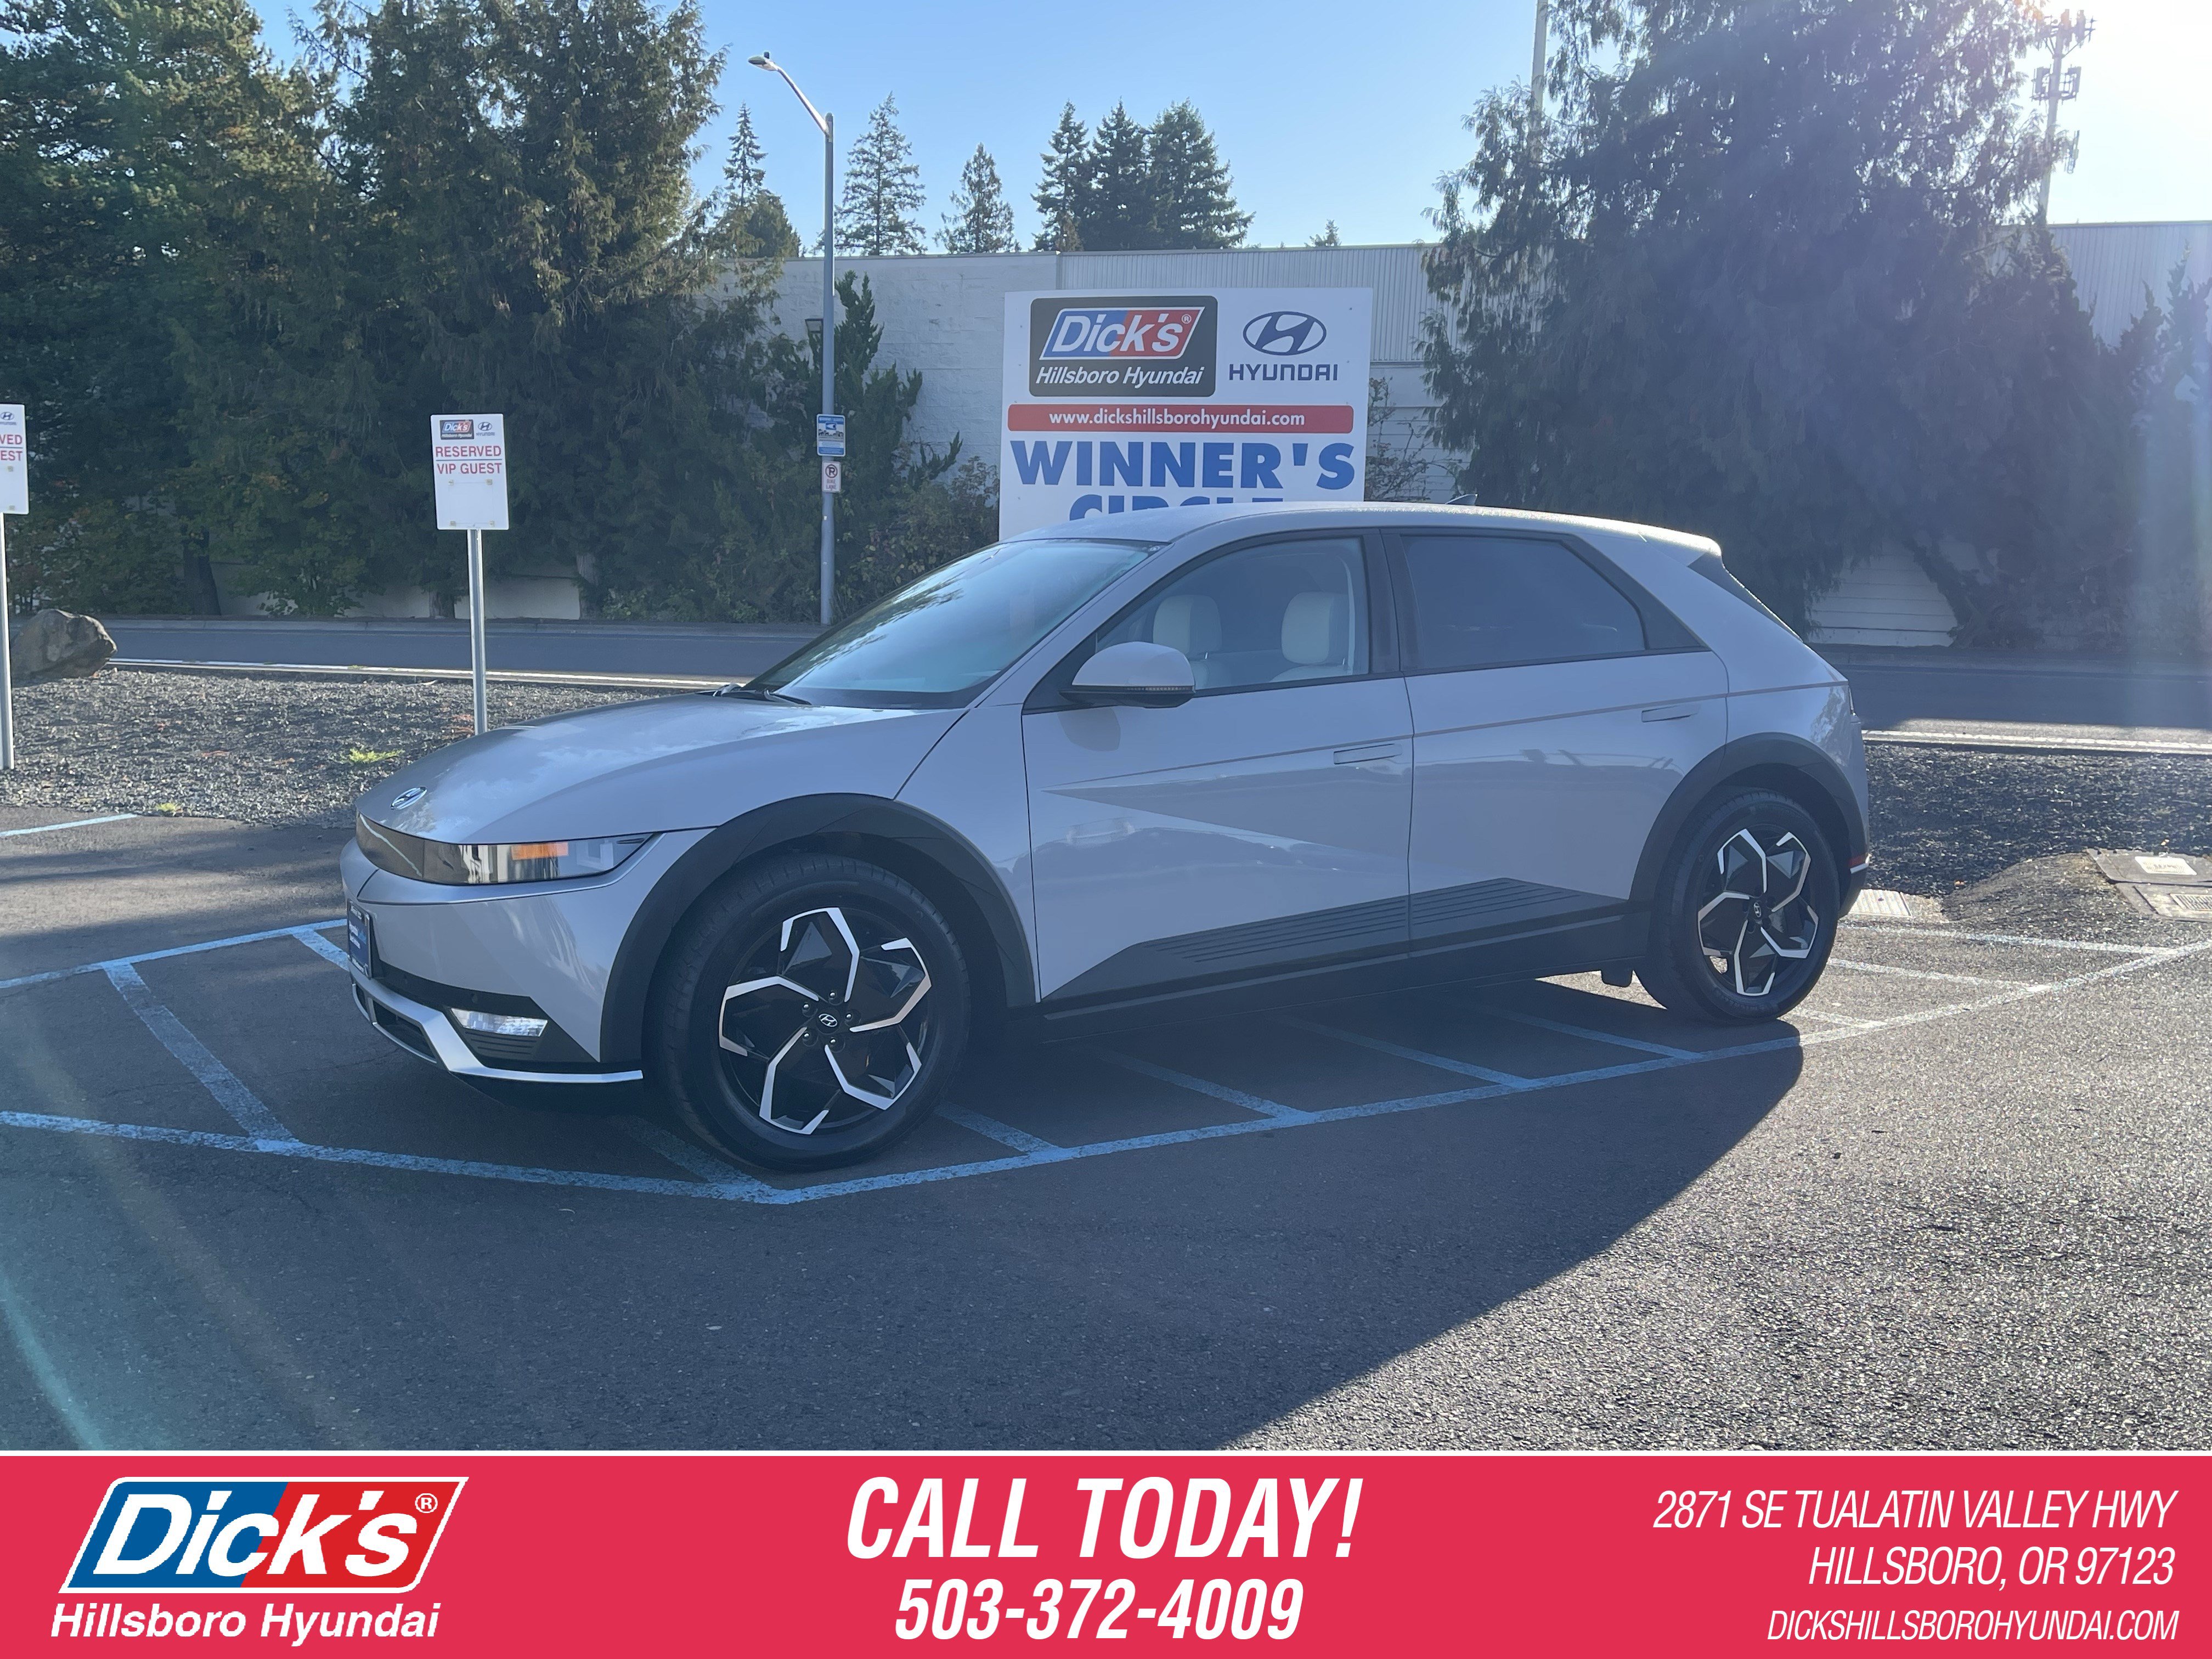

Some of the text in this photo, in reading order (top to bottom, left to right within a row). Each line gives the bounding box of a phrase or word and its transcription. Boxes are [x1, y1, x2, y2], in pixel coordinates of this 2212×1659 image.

[1052, 313, 1183, 352] Dick's
[1036, 366, 1205, 388] Hillsboro Hyundai
[1229, 364, 1338, 381] HYUNDAI
[1049, 408, 1305, 429] www.dickshillsborohyundai.com
[435, 445, 501, 457] RESERVED
[437, 462, 502, 474] VIP GUEST
[1010, 441, 1355, 490] WINNER'S
